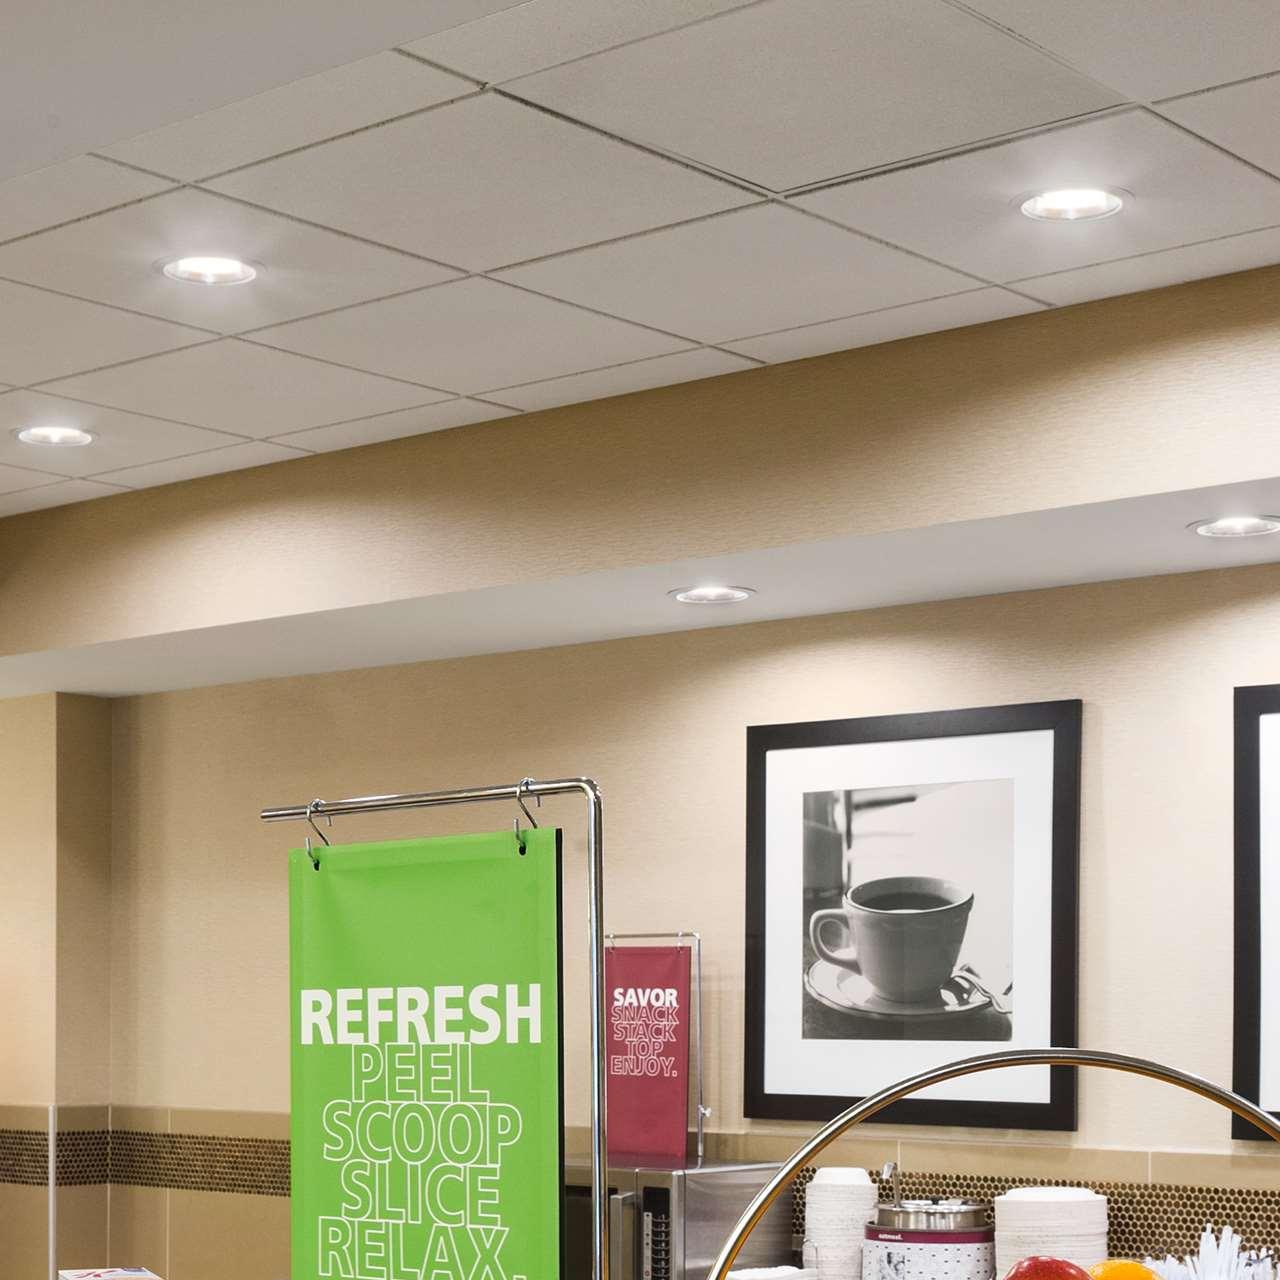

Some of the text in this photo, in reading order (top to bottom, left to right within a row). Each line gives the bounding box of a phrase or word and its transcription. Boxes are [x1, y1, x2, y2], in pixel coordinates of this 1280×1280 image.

[613, 987, 679, 1007] SAVOR
[300, 983, 542, 1045] REFRESH
[611, 1005, 680, 1024] SNACK
[613, 1021, 676, 1041] STACK
[626, 1038, 664, 1058] TOP
[351, 1041, 490, 1104] PEEL
[610, 1055, 678, 1077] ENJOY.
[322, 1099, 523, 1167] SCOOP
[341, 1158, 501, 1229] SLICE
